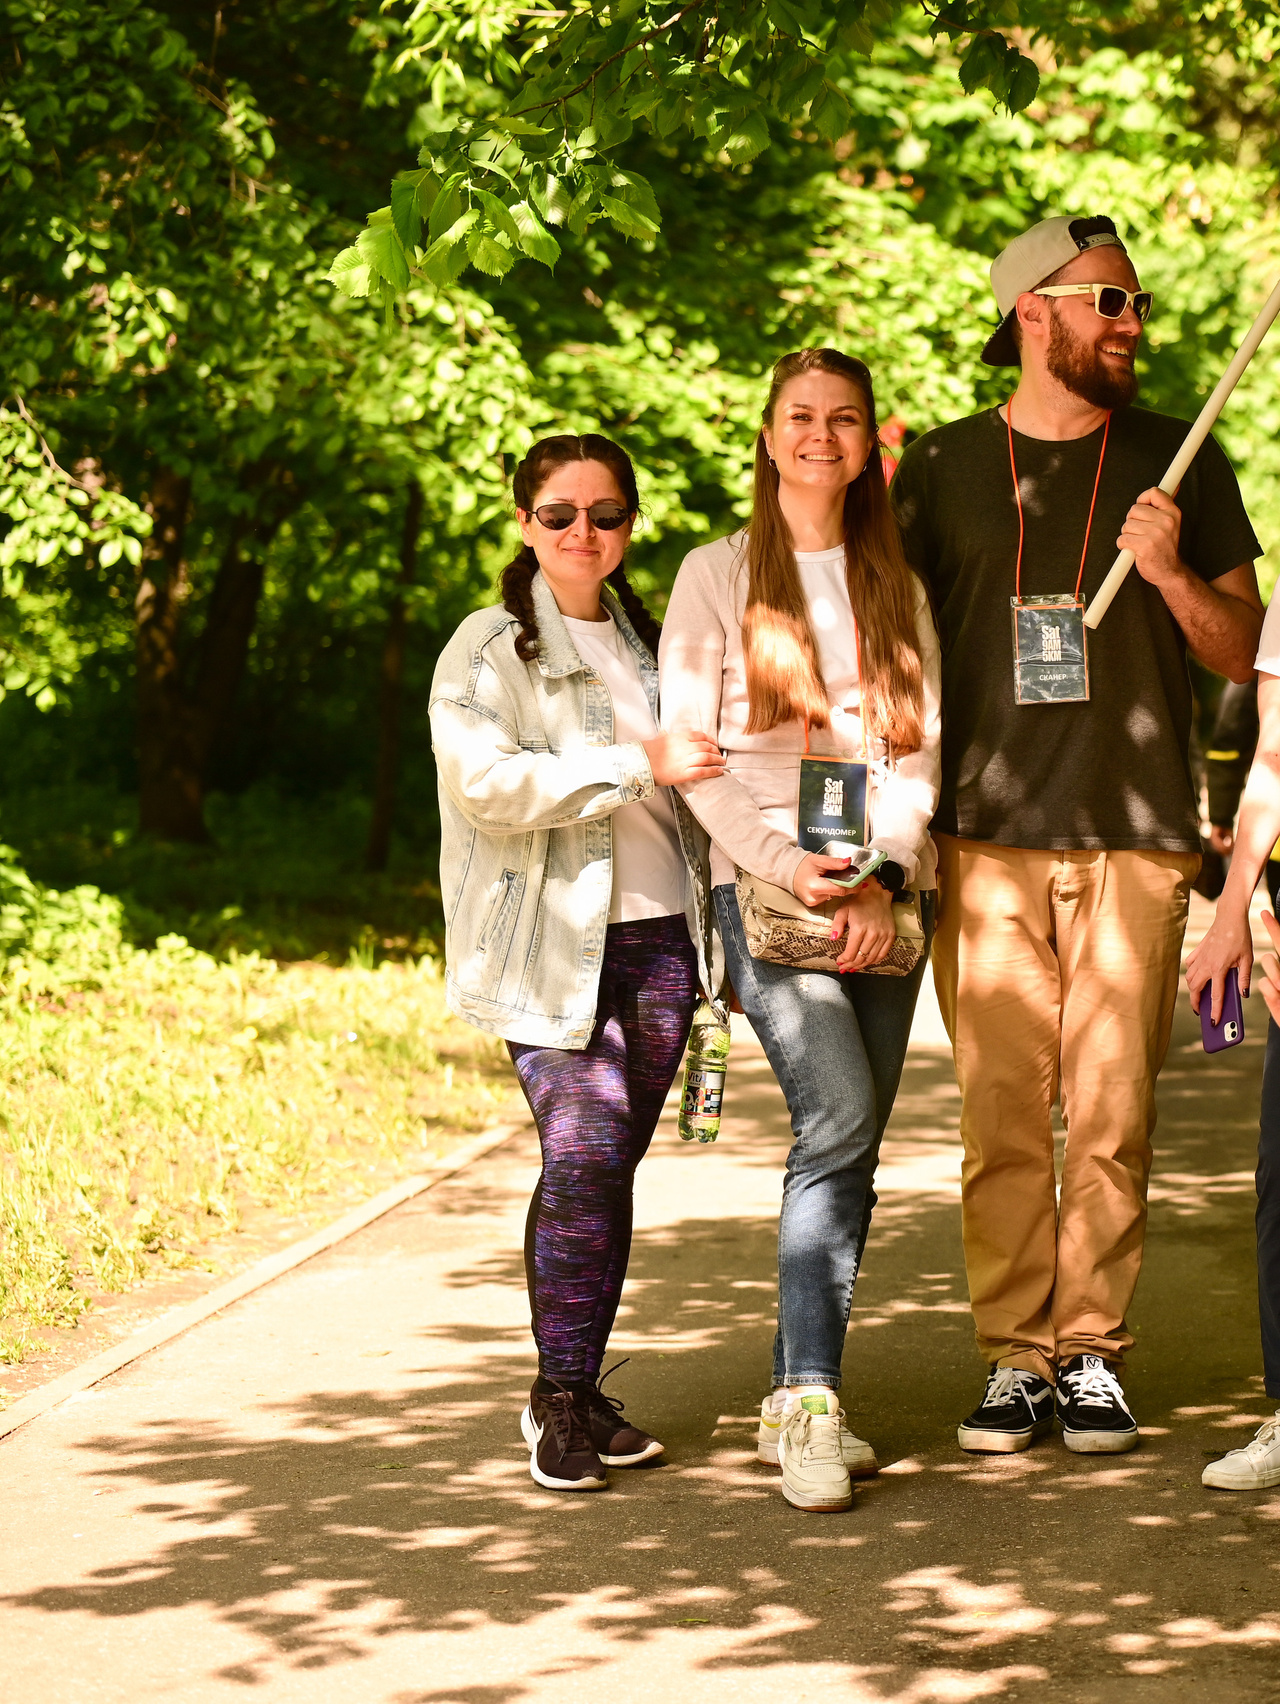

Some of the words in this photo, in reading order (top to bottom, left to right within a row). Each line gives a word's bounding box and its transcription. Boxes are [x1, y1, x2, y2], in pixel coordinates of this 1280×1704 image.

[1042, 625, 1060, 639] Sat
[1042, 639, 1061, 651] 9AM
[1042, 651, 1062, 662] 5KM
[824, 777, 844, 794] Sat
[823, 792, 844, 805] 9AM
[822, 803, 843, 817] 5KM
[807, 826, 857, 836] СЕКУНДОМЕР
